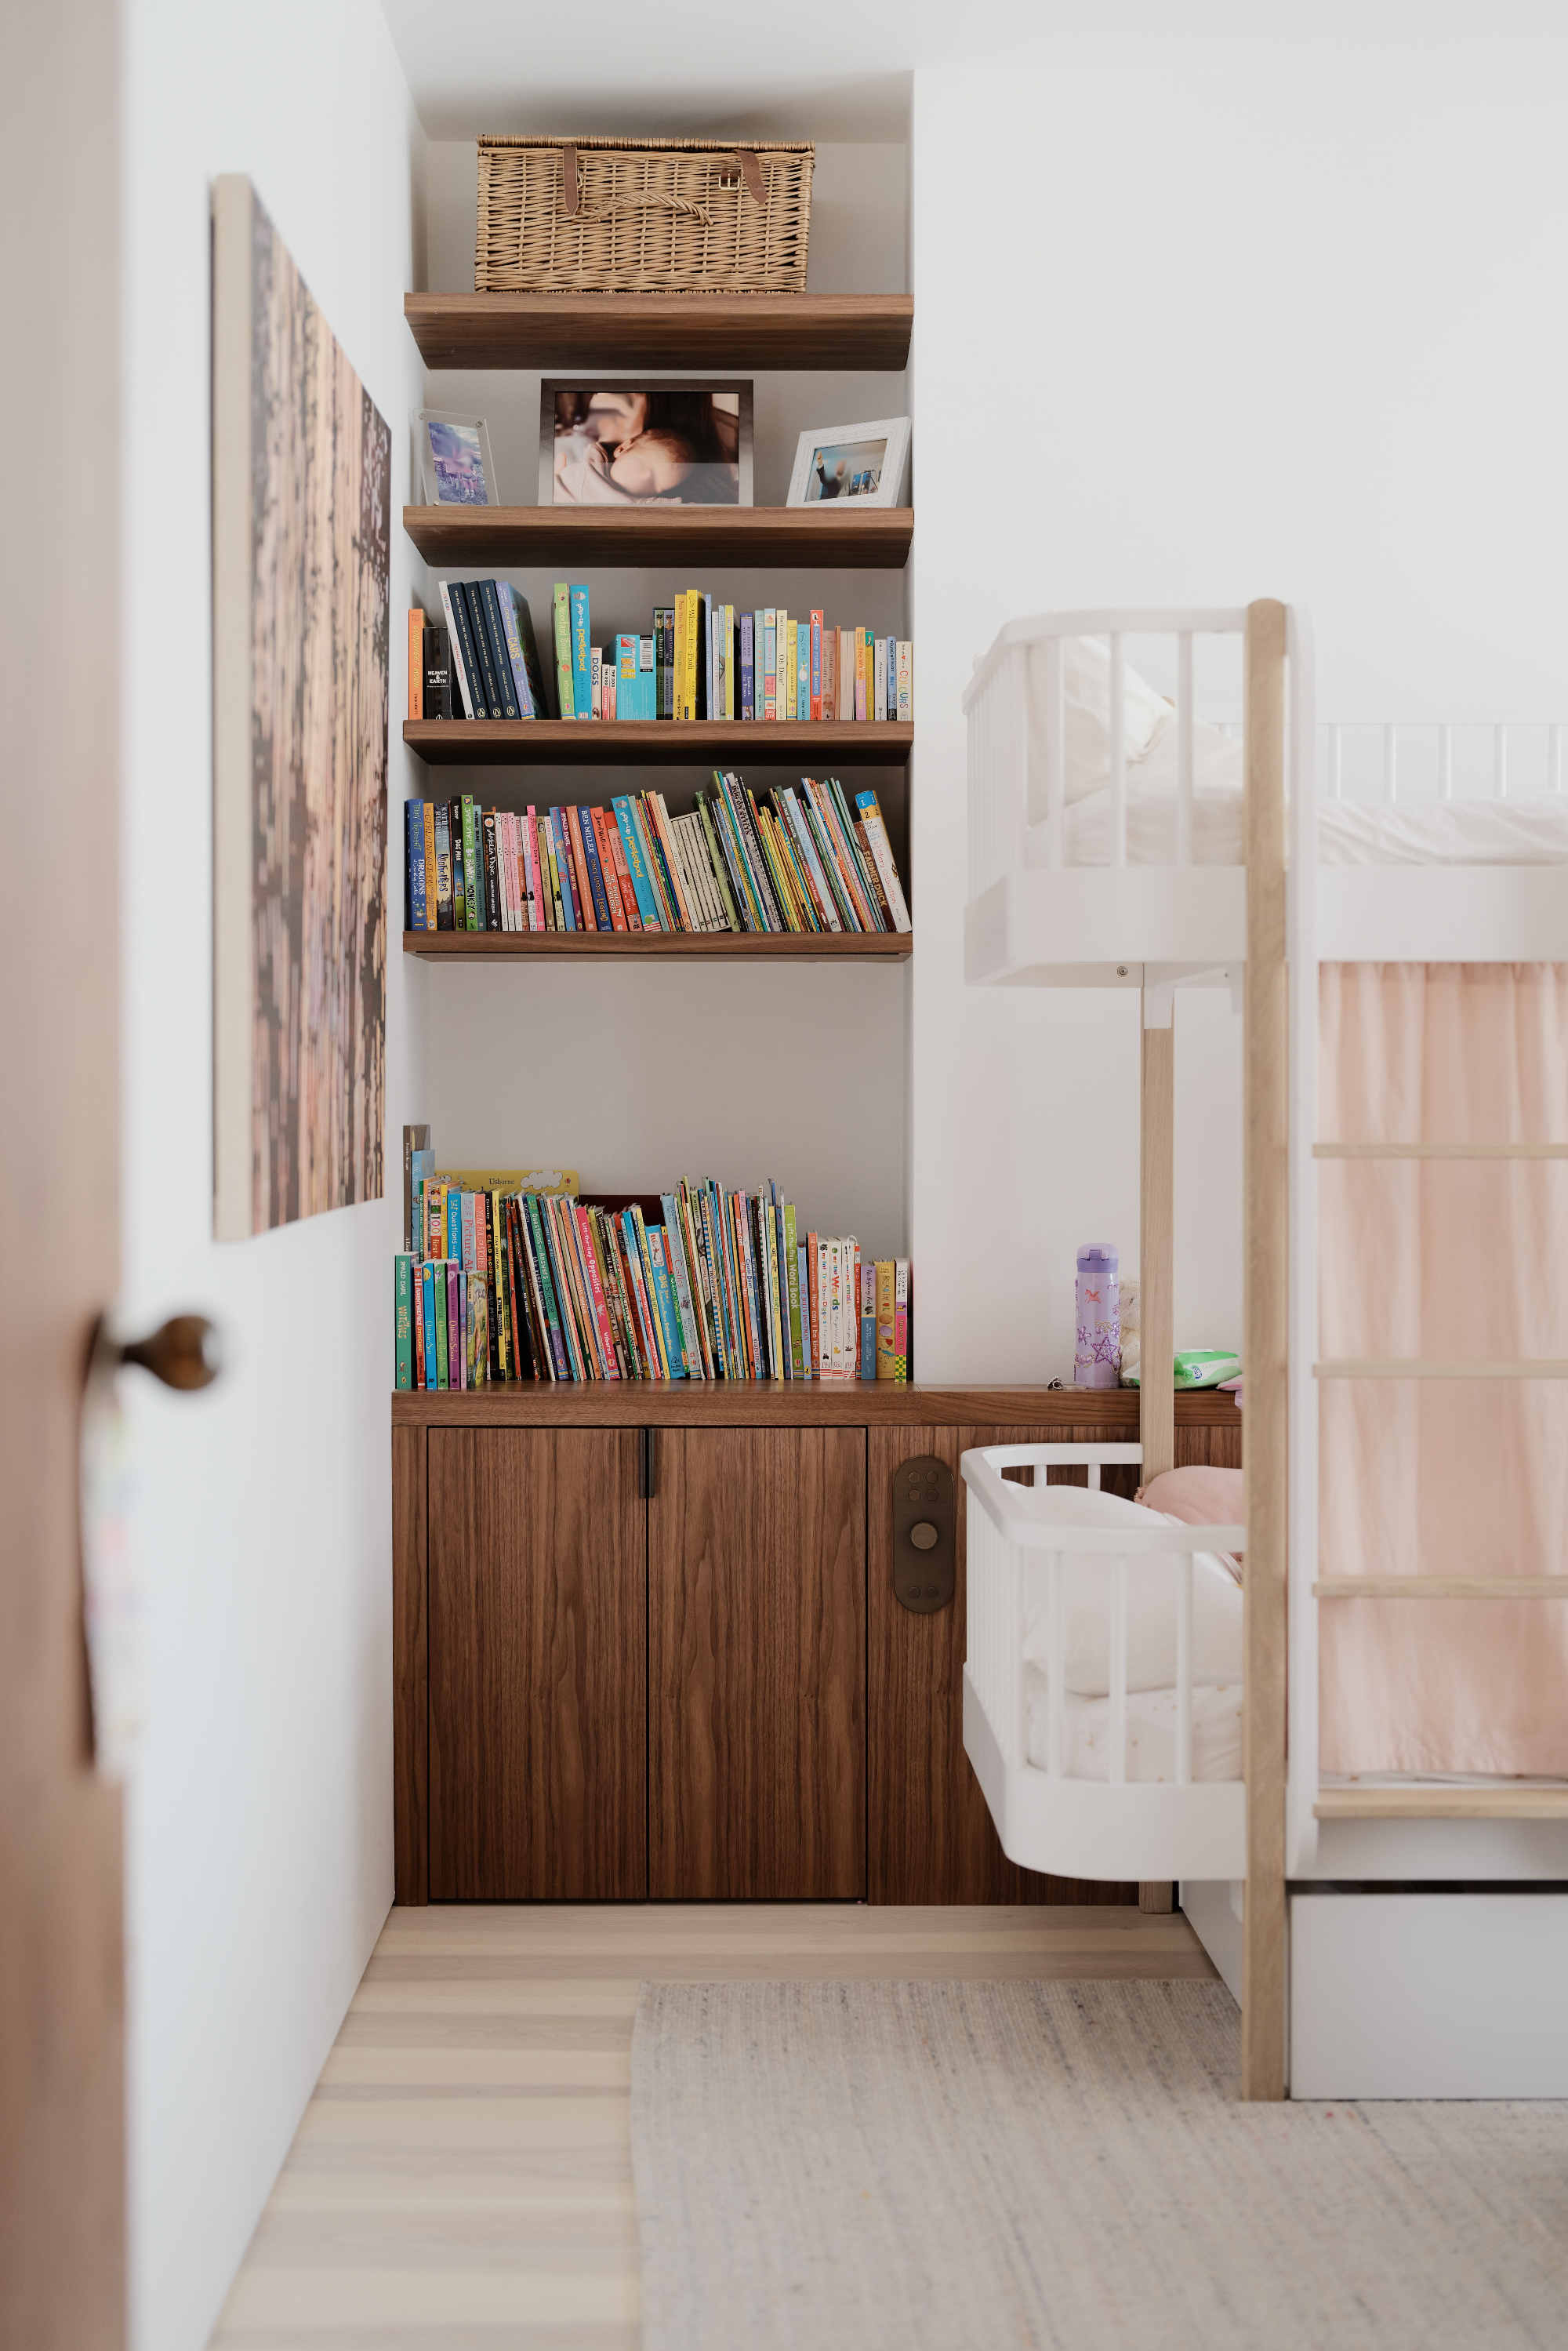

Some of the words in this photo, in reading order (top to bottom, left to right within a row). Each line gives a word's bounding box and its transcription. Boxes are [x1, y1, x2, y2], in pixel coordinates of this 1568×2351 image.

[558, 606, 569, 636] Woodland
[575, 603, 584, 627] pop-up
[507, 637, 521, 660] CARS
[560, 638, 569, 660] Sounds
[576, 629, 586, 671] peekaboo!
[779, 655, 786, 665] Oh
[898, 670, 909, 709] COLOURS
[412, 802, 421, 820] TERRY
[581, 810, 590, 825] BEN
[584, 827, 594, 854] MILLER
[619, 812, 630, 834] pop-up
[626, 836, 644, 878] peekaboo!
[466, 859, 474, 880] BUNNY
[558, 872, 568, 883] BFG
[863, 851, 879, 883] FARMER
[873, 884, 887, 907] DUCK
[876, 849, 887, 868] Story
[882, 870, 897, 904] Collection
[466, 884, 476, 910] MONKEY
[607, 887, 617, 914] CHILDREN
[597, 898, 608, 921] LEGEND
[431, 1215, 441, 1234] 100
[464, 1219, 473, 1255] Picture
[532, 1213, 543, 1245] Questions
[539, 1252, 549, 1280] Answers
[544, 1286, 555, 1314] Science
[582, 1223, 593, 1258] Lift-the-flap
[589, 1259, 601, 1294] Opposites
[658, 1274, 668, 1289] BIG
[674, 1259, 684, 1288] Castles
[788, 1264, 797, 1285] Word
[790, 1288, 799, 1310] Book
[398, 1306, 408, 1339] WITCHES
[812, 1329, 818, 1339] be
[604, 1332, 612, 1355] Usborne
